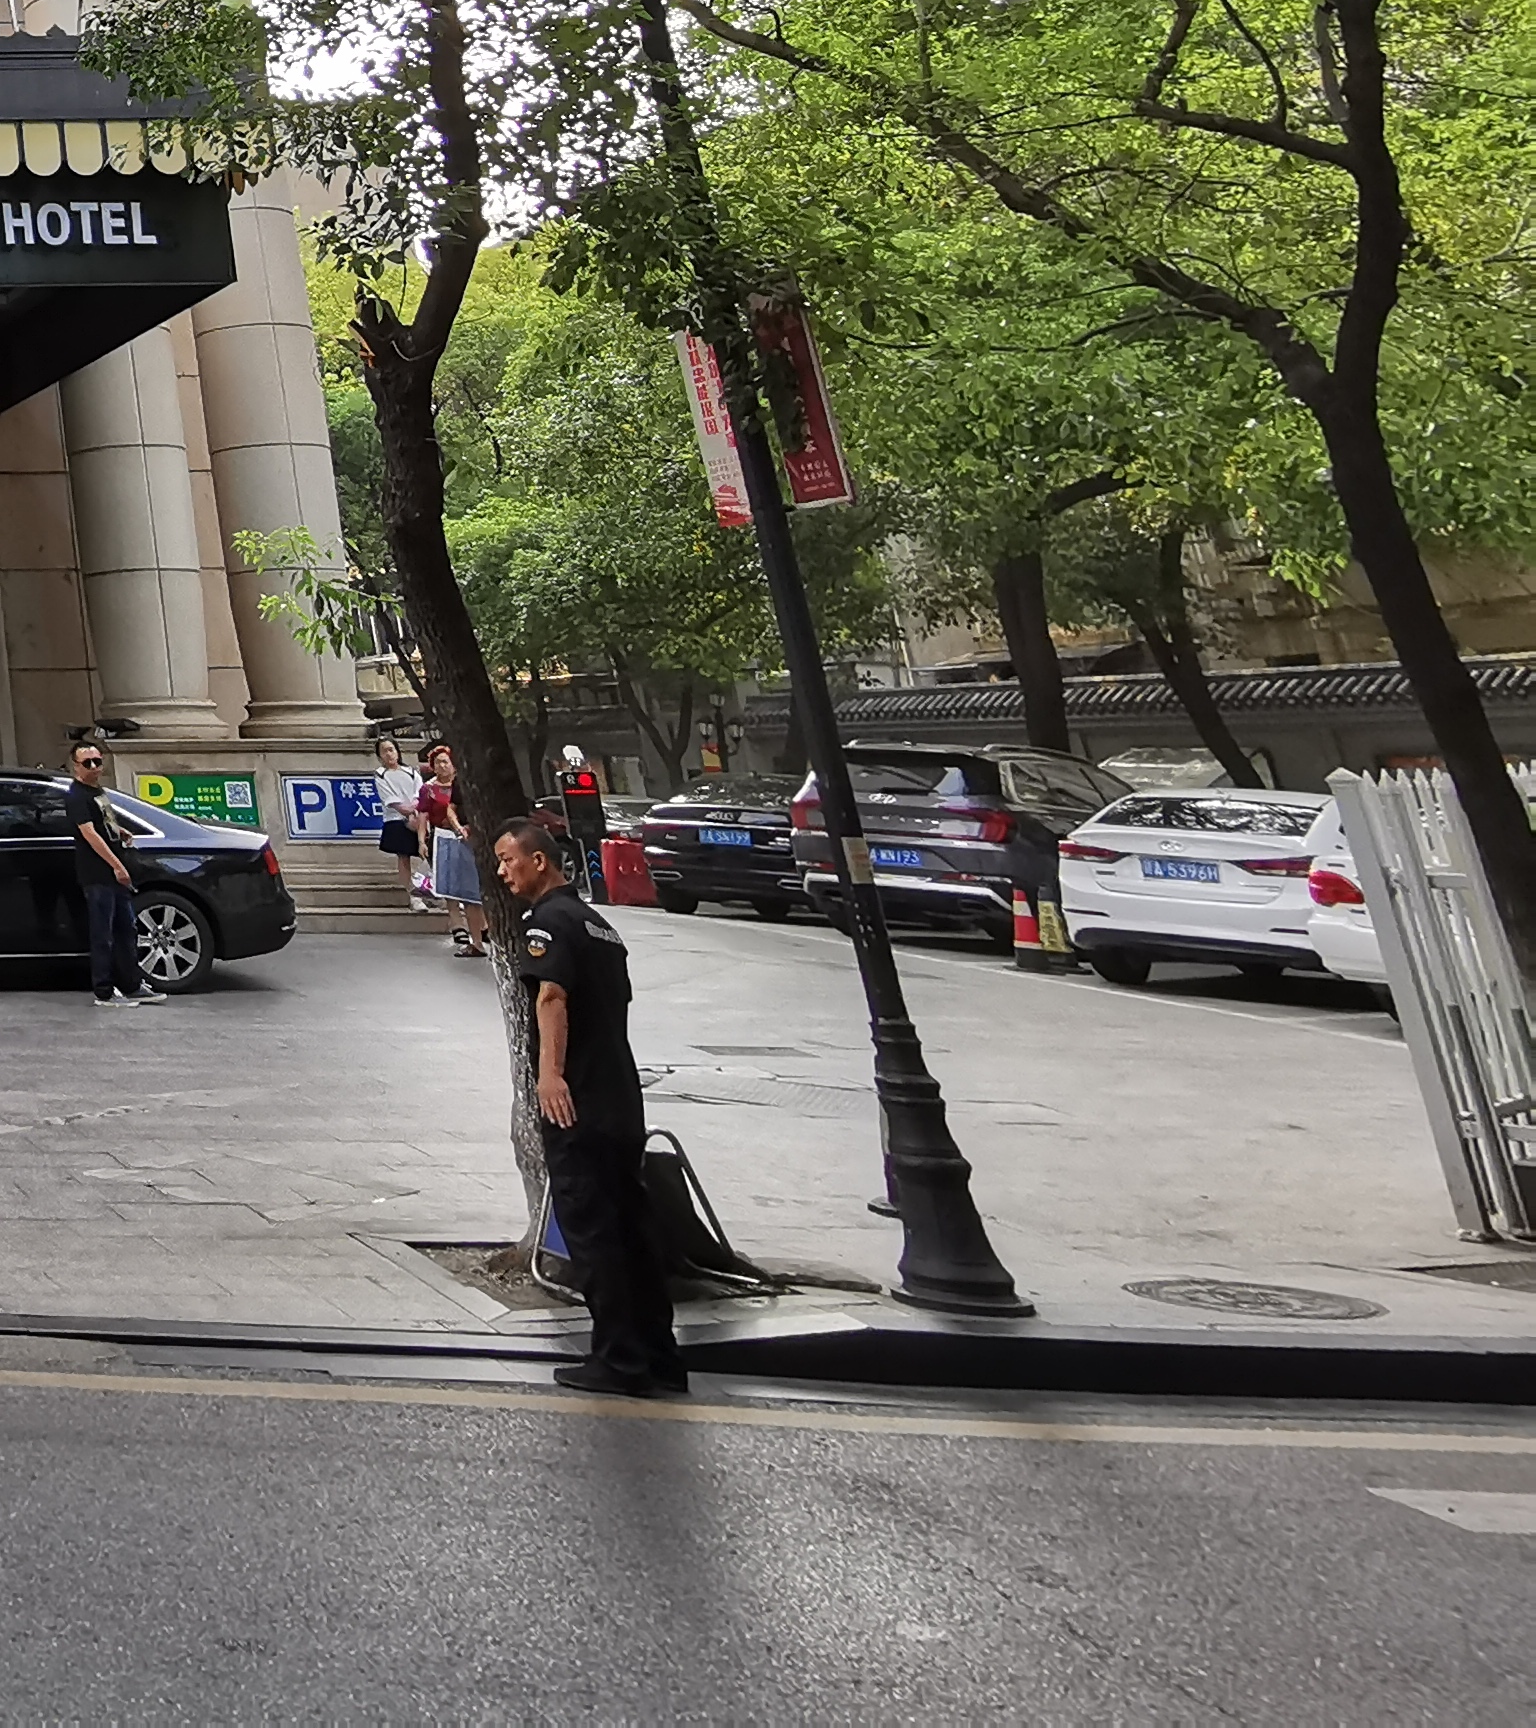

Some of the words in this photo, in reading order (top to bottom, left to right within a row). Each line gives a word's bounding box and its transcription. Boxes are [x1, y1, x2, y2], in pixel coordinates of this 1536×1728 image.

[2, 200, 158, 247] HOTEL
[339, 781, 375, 799] 停车
[353, 800, 384, 818] 入口
